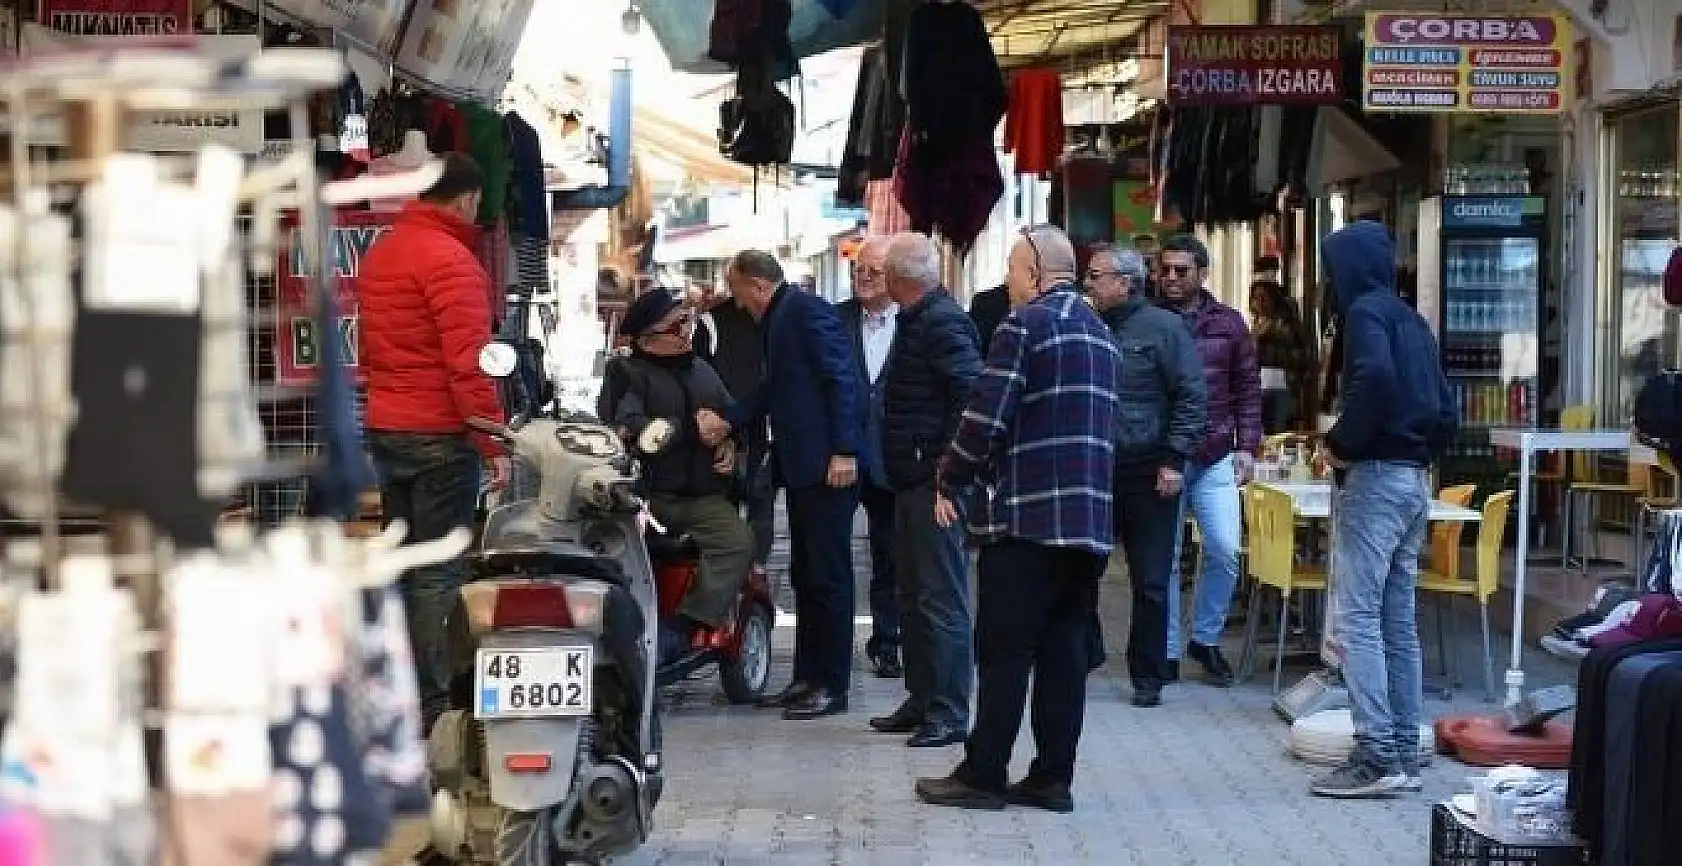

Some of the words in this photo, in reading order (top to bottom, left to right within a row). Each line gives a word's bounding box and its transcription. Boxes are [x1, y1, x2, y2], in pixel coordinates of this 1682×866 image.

[1389, 18, 1542, 42] ÇORBA
[1178, 34, 1246, 60] YAMAK
[1251, 32, 1339, 60] SOFRASI
[1178, 68, 1250, 99] ÇORBA
[1257, 68, 1336, 94] IZGARA
[488, 655, 520, 678] 48
[567, 652, 582, 676] K
[510, 683, 582, 708] 6802
